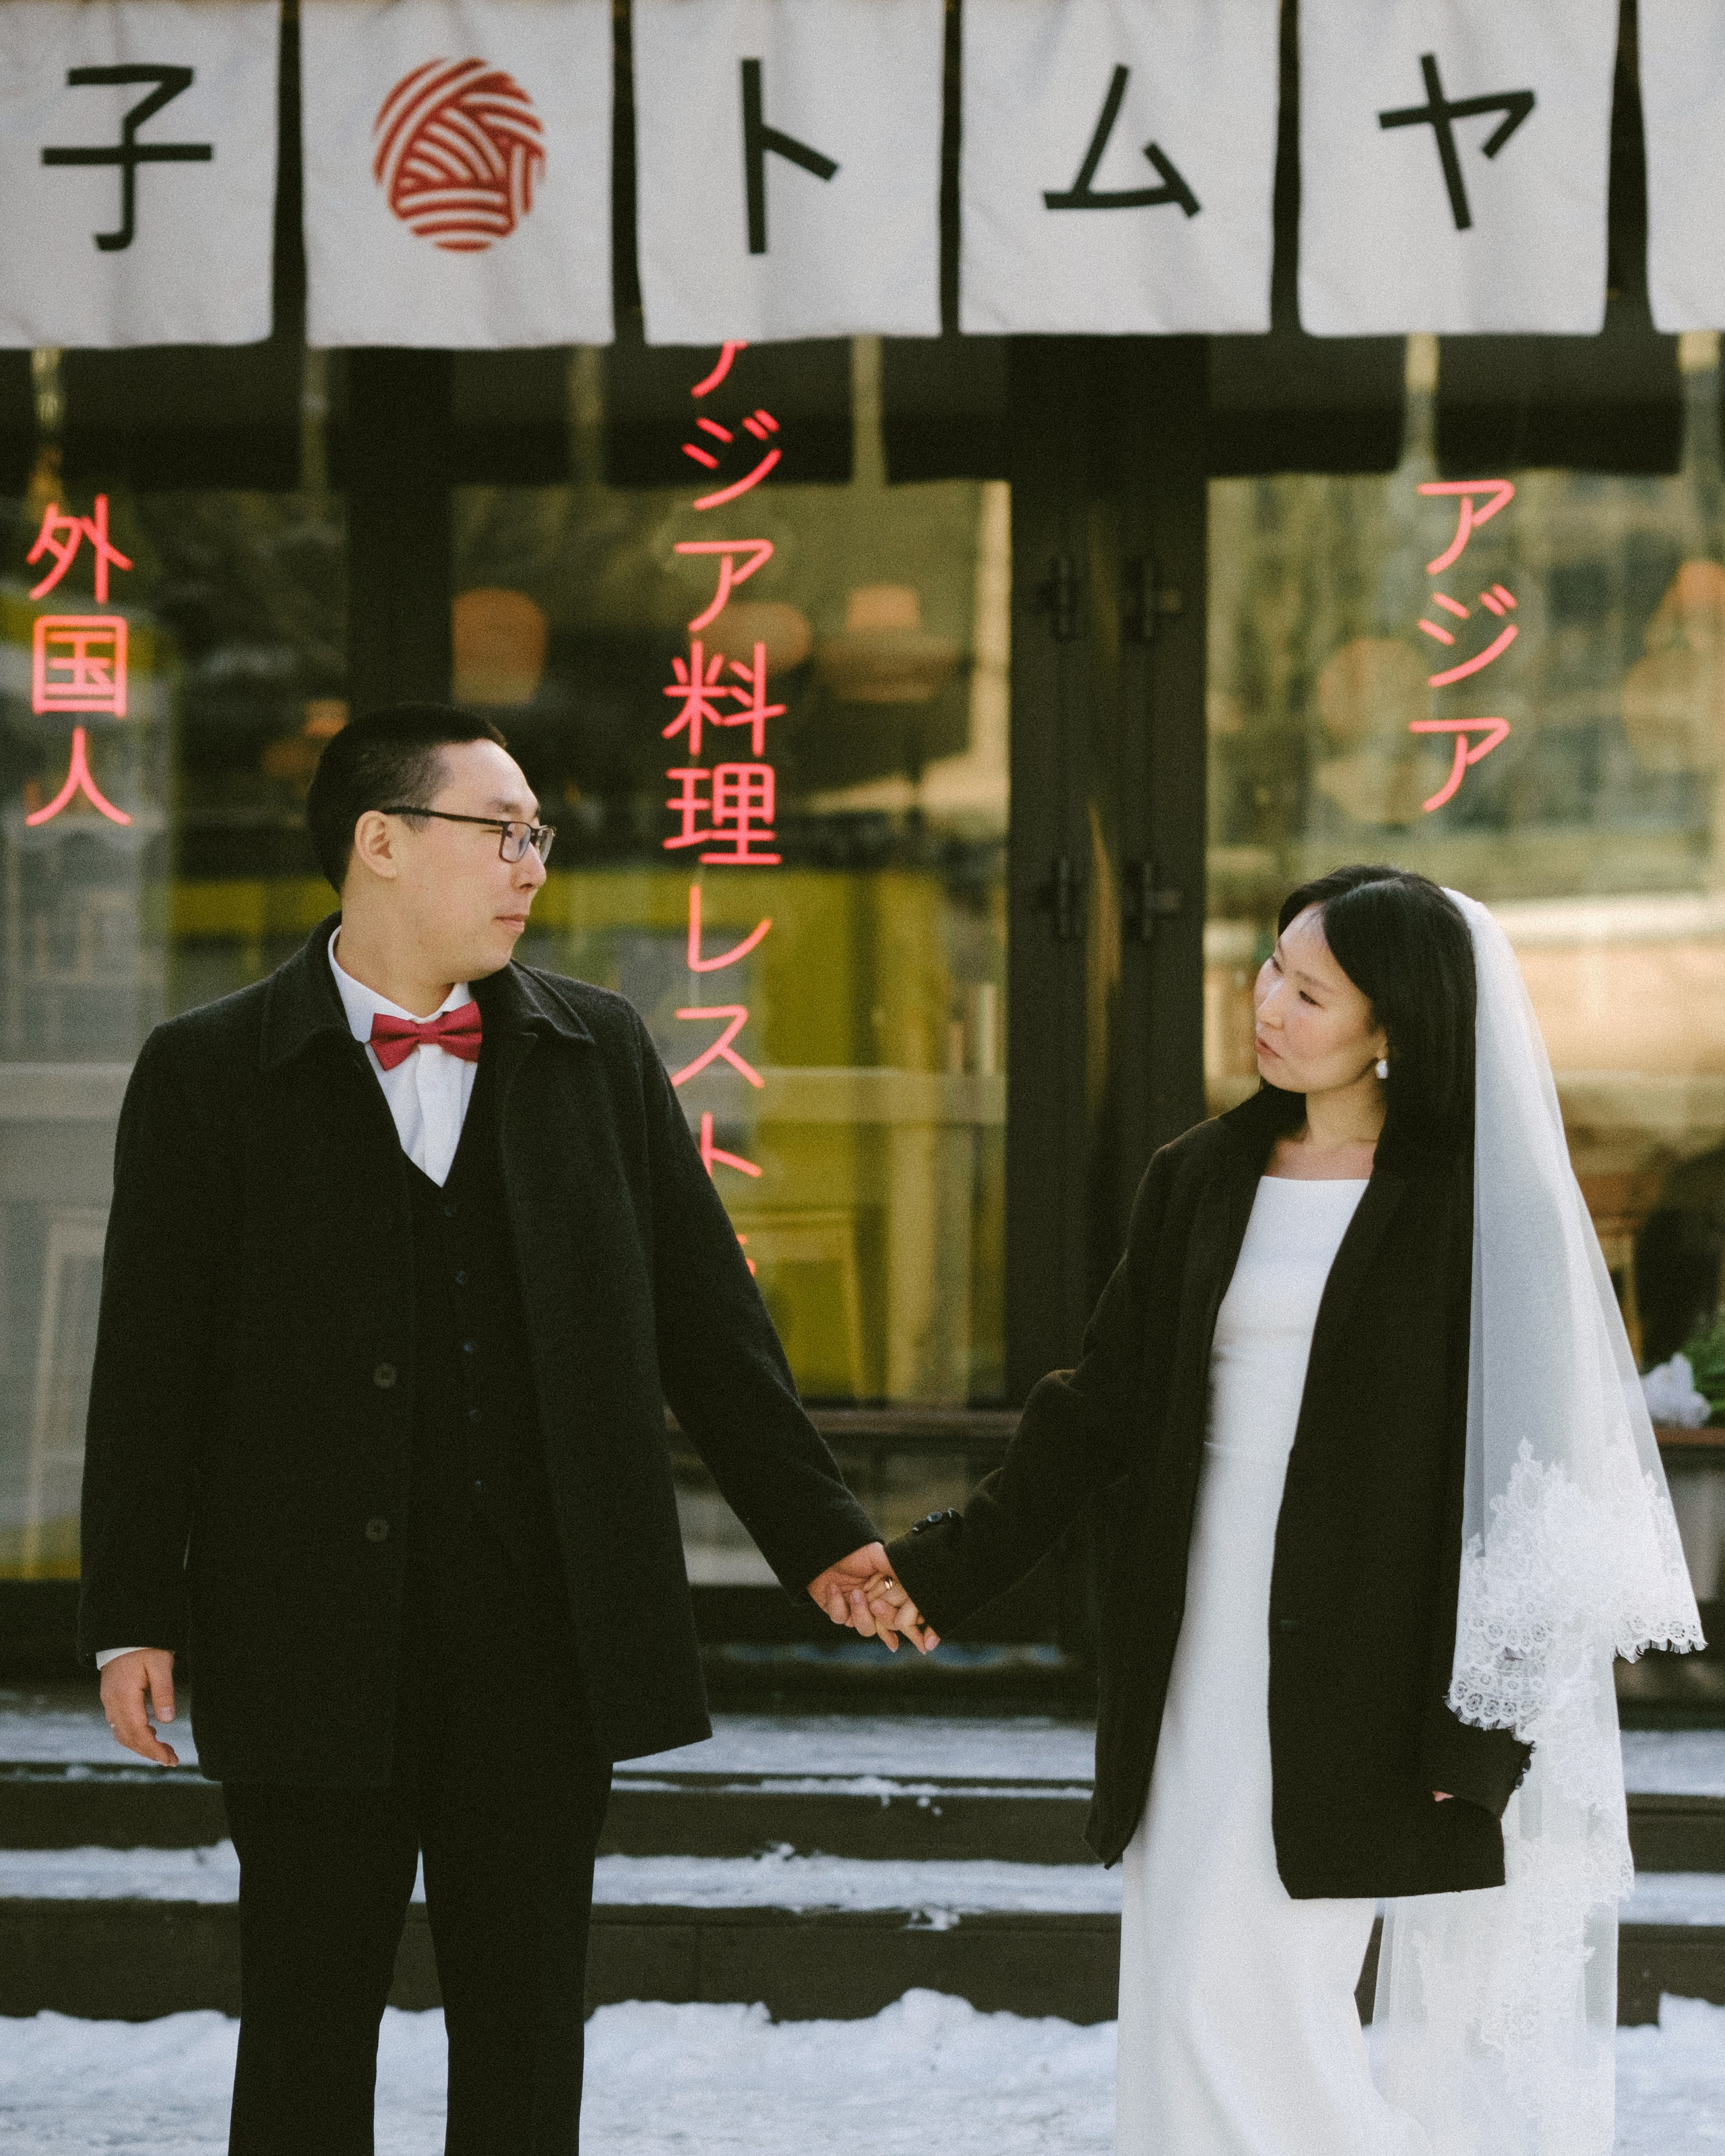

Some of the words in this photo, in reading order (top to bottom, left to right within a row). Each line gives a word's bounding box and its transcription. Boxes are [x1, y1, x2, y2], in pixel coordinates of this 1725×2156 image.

[41, 63, 215, 253] 子
[26, 494, 133, 827] 外国人
[1409, 479, 1519, 813] アジア
